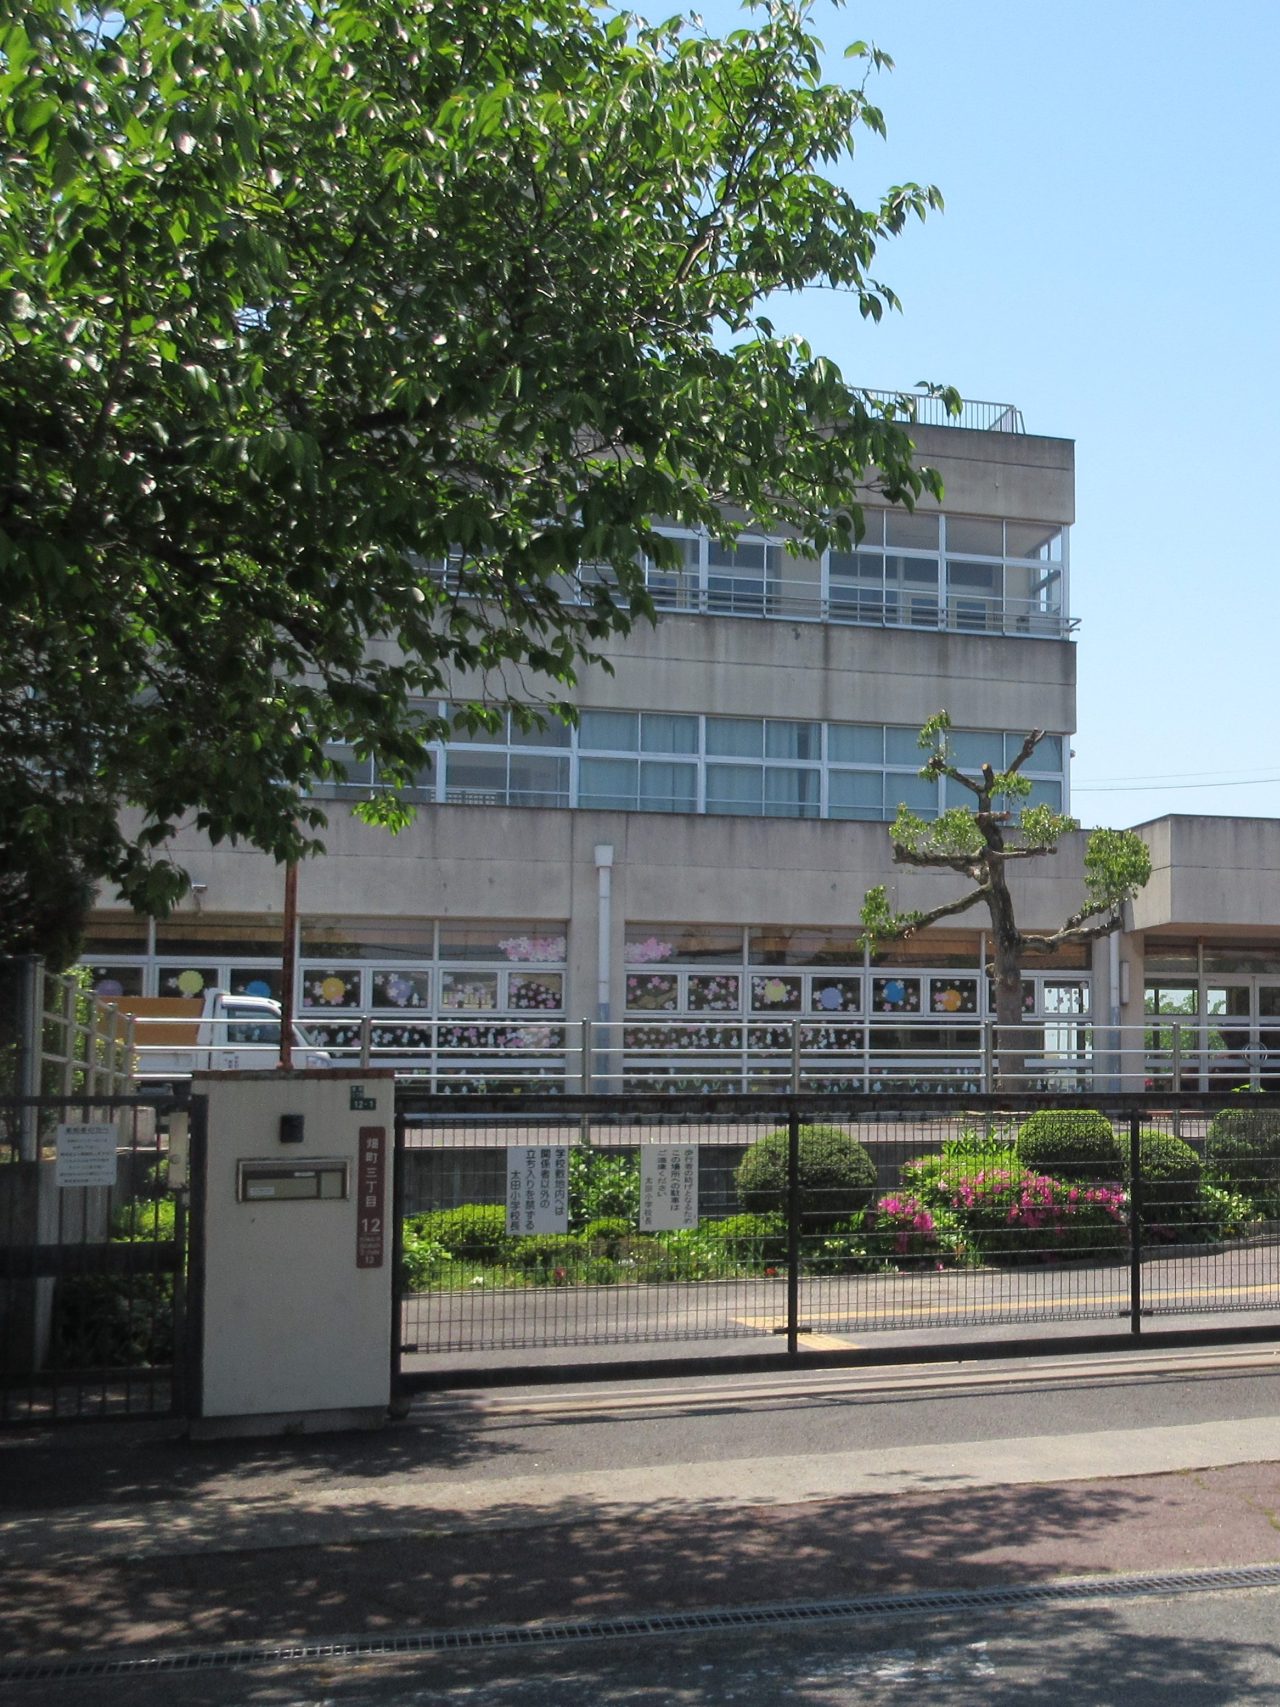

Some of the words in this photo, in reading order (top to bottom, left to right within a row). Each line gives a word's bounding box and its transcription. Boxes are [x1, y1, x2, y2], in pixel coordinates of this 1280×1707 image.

[365, 1137, 380, 1208] 畑町三丁目
[510, 1169, 521, 1232] 太田小学校長
[525, 1149, 536, 1231] 立ち入りを禁ずる
[539, 1148, 551, 1209] 関係者以外の
[554, 1148, 566, 1216] 学校敷地内へは
[670, 1149, 681, 1212] この場所への駐車は
[361, 1217, 381, 1233] 12
